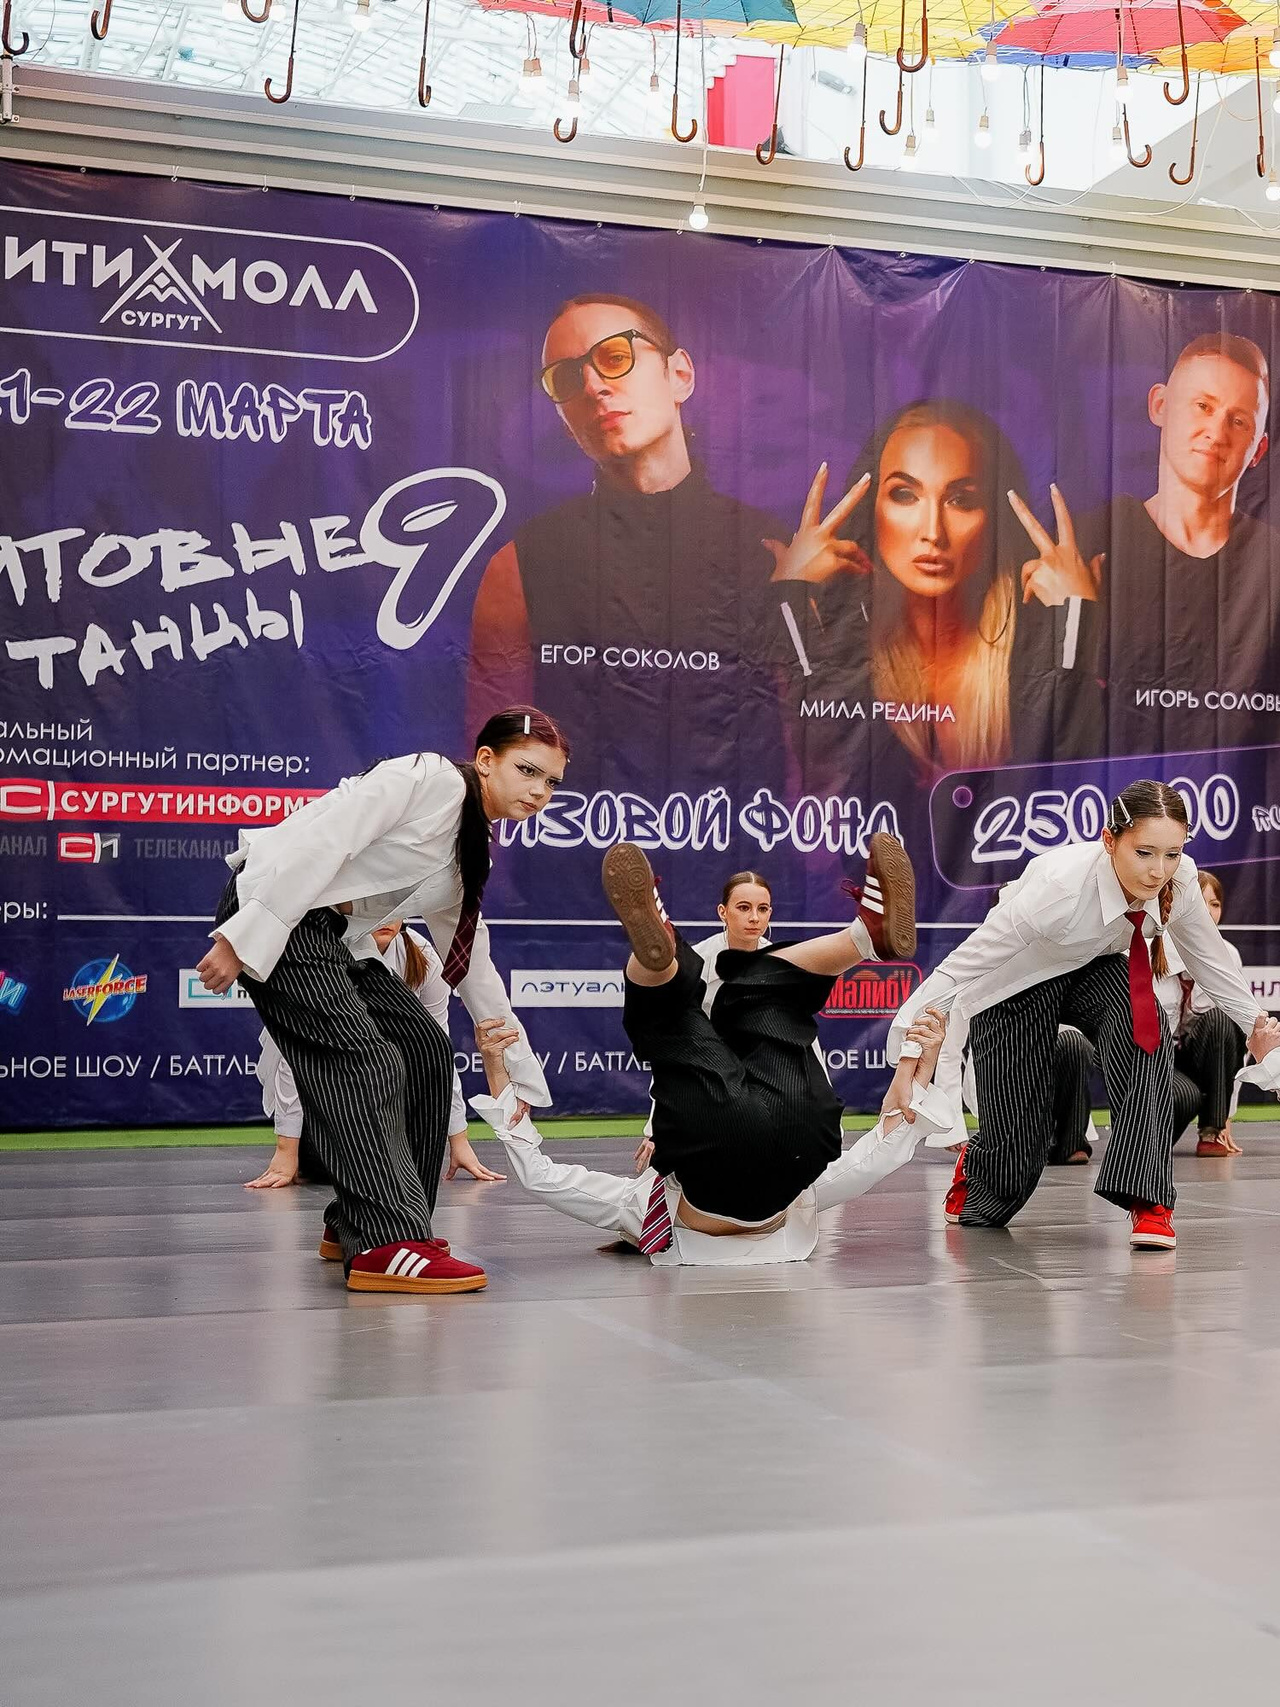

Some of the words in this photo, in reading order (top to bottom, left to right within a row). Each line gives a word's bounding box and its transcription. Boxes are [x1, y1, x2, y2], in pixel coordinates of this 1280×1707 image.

[4, 235, 134, 288] ИТИ
[121, 309, 202, 331] СУРГУТ
[0, 367, 162, 434] 1-22
[176, 378, 373, 450] МАРТА
[6, 588, 304, 690] ТАНЦЫ
[540, 643, 597, 666] ЕГОР
[602, 646, 721, 671] СОКОЛОВ
[799, 699, 867, 721] МИЛА
[871, 701, 957, 724] РЕДИНА
[1135, 688, 1200, 709] ИГОРЬ
[186, 752, 311, 778] партнер:
[60, 789, 324, 818] СУРГУТИНФОРМ
[499, 786, 732, 851] ИЗОВОЙ
[0, 836, 48, 858] АНАЛ
[62, 973, 149, 1002] LASERFORCE
[76, 1055, 142, 1078] ШОУ
